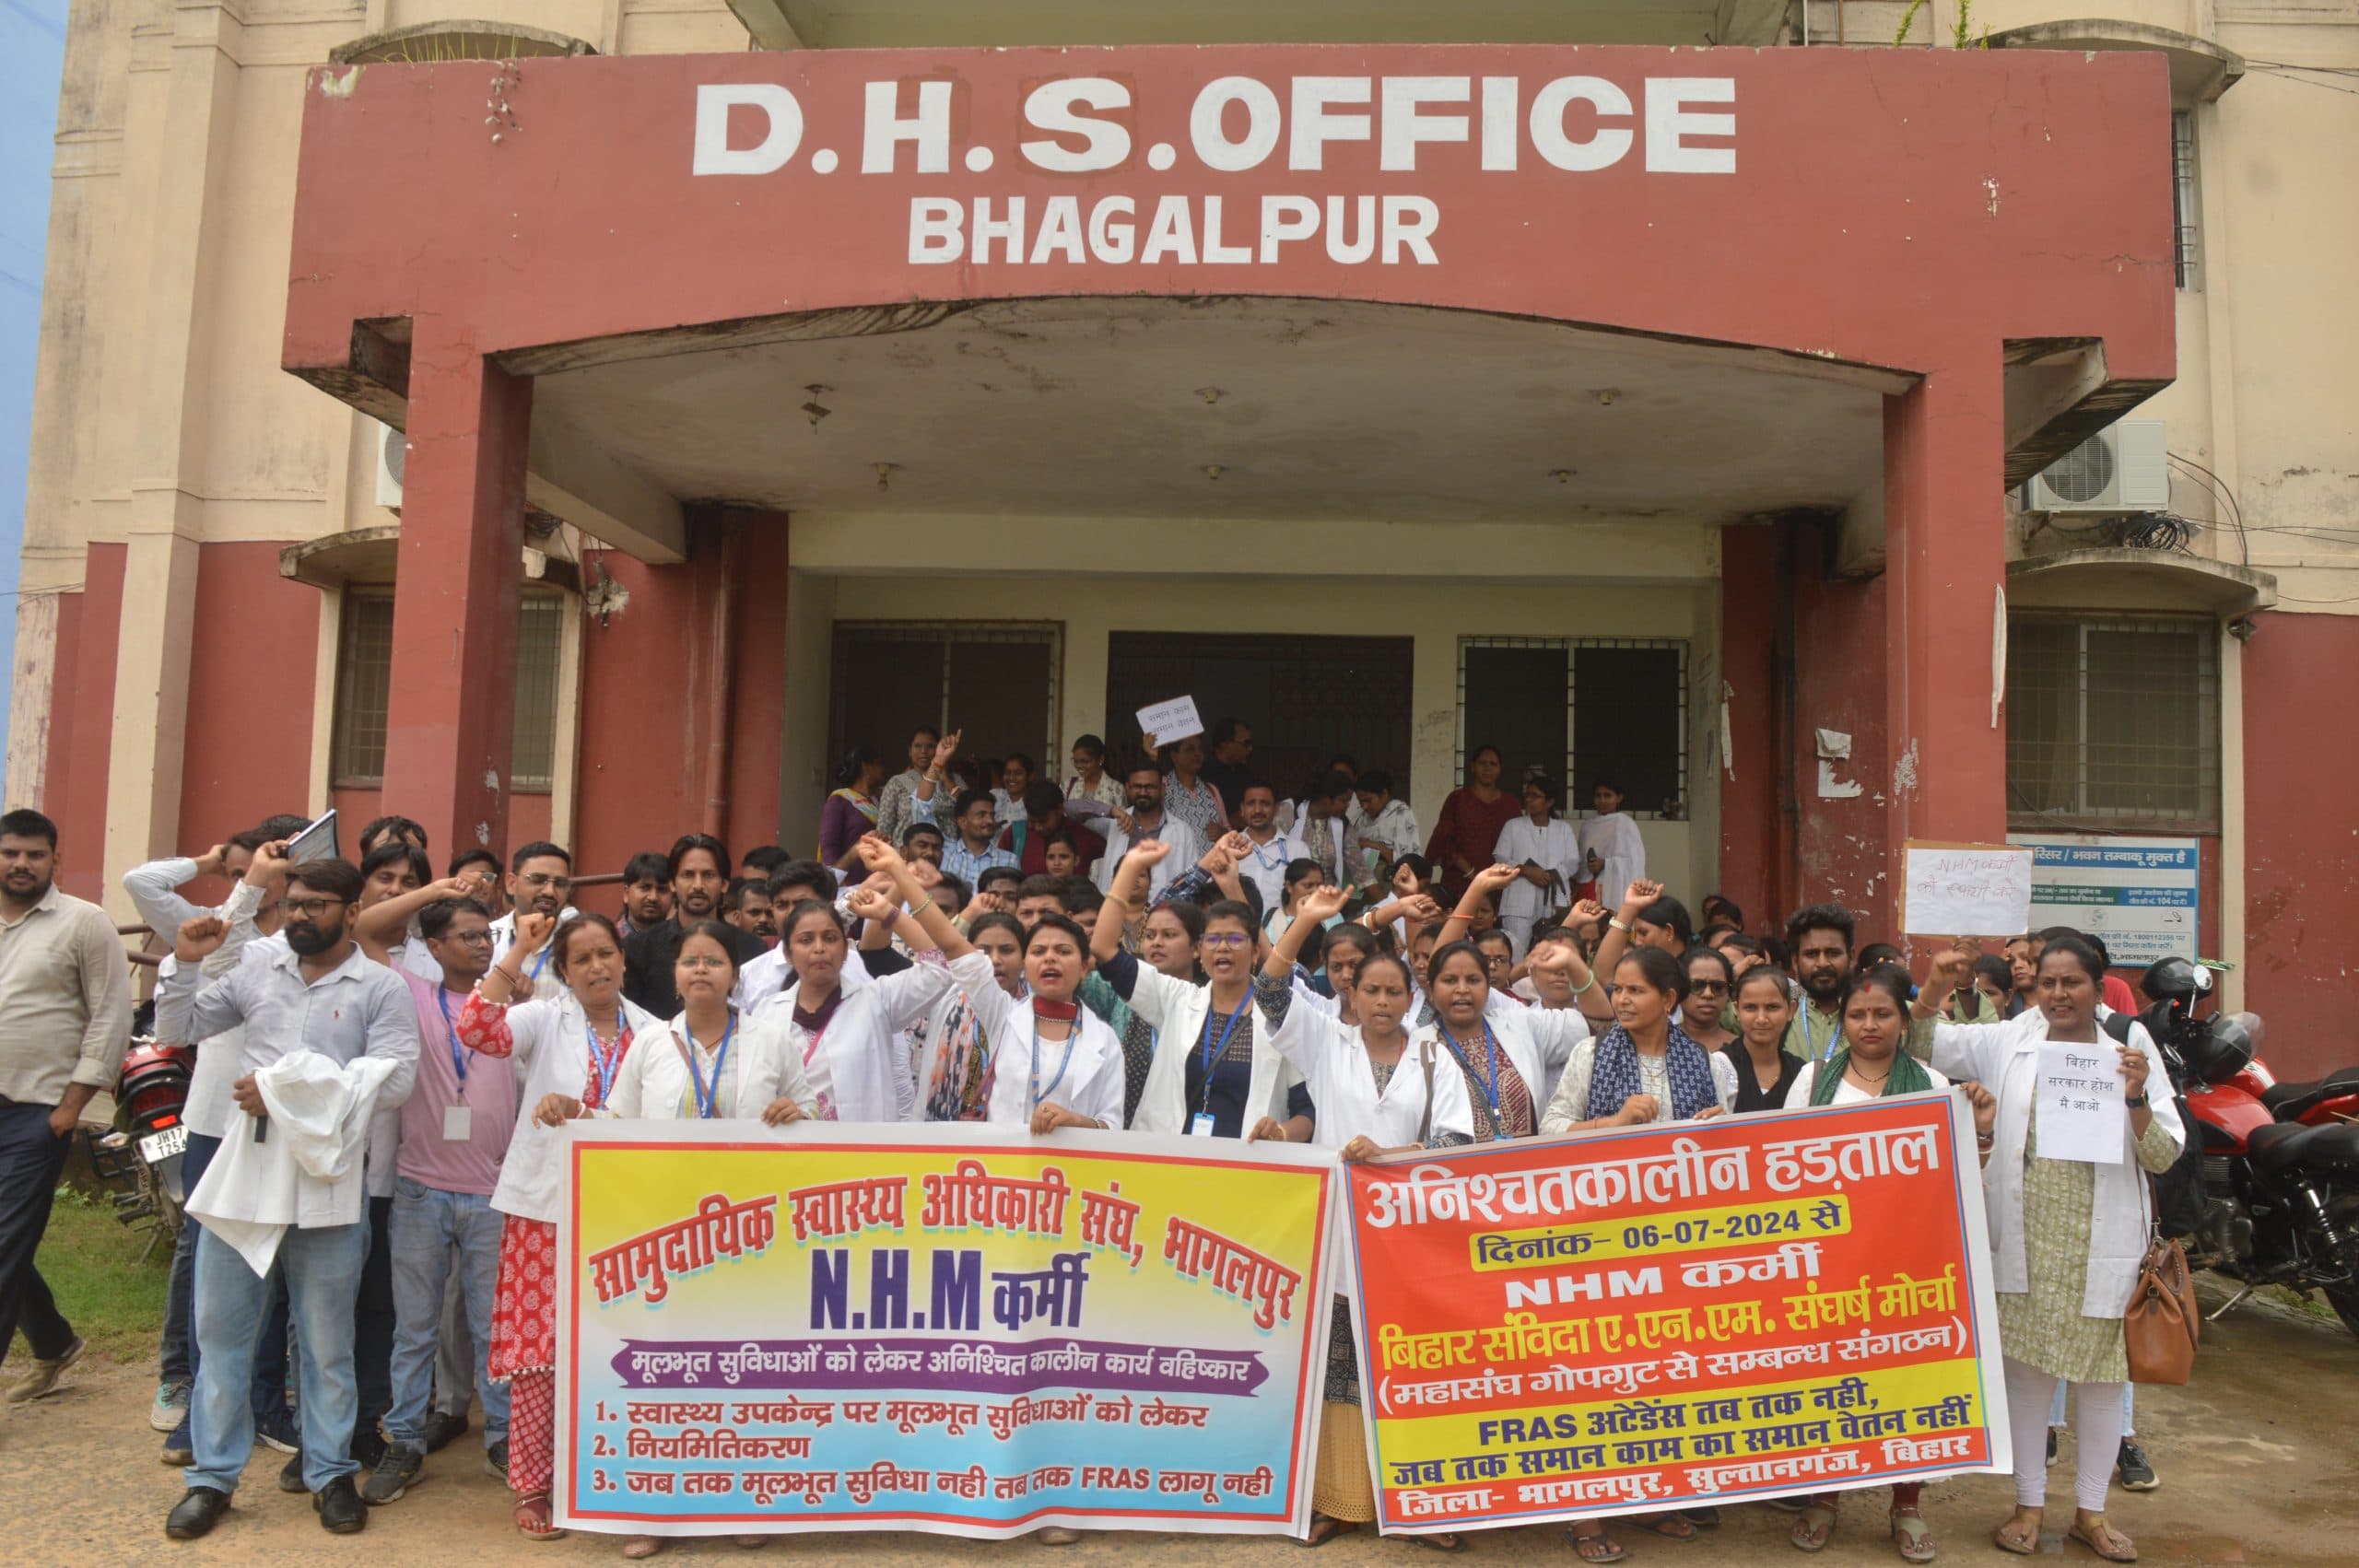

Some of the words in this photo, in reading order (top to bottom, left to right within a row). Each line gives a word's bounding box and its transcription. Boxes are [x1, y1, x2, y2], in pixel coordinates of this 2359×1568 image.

[908, 194, 1440, 264] BHAGALPUR
[2034, 846, 2063, 860] रिसर
[2073, 849, 2102, 861] भवन
[2176, 848, 2187, 864] है
[2157, 896, 2171, 906] 104
[2048, 1076, 2087, 1090] सरकार
[2091, 1077, 2114, 1094] होश
[2065, 1053, 2099, 1071] बिहार
[2073, 1097, 2101, 1112] आओ
[157, 1127, 182, 1145] JH17
[1762, 1123, 1940, 1191] हड़ताल
[588, 1193, 777, 1304] सामुदायिक
[788, 1176, 908, 1242] स्वास्थ्य
[921, 1159, 1071, 1235] अधिकारी
[1081, 1181, 1144, 1268] संघ,
[1164, 1216, 1302, 1330] भागलपुर
[1624, 1209, 1802, 1249] 06-07-2024
[1809, 1199, 1842, 1230] से
[810, 1248, 981, 1330] N.H.M
[992, 1252, 1091, 1330] कर्मी
[1505, 1266, 1663, 1308] NHM
[1681, 1241, 1824, 1289] कर्मी
[1379, 1323, 1477, 1371] बिहार
[1482, 1311, 1591, 1362] संविदा
[1783, 1274, 1872, 1331] संघर्ष
[1876, 1263, 1957, 1317] मोर्चा
[631, 1350, 712, 1384] मूलभूत
[718, 1343, 823, 1384] सुविधाओं
[826, 1343, 857, 1373] को
[863, 1343, 923, 1373] लेकर
[927, 1342, 1027, 1376] अनिश्चित
[1030, 1341, 1100, 1373] कालीन
[1105, 1348, 1156, 1375] कार्य
[1158, 1349, 1251, 1381] वहिष्कार
[1379, 1367, 1522, 1415] (महासंघ
[1528, 1360, 1661, 1395] गोपगुट
[1663, 1351, 1700, 1380] से
[1704, 1341, 1832, 1376] सम्बन्ध
[1836, 1316, 1967, 1359] संगठन)
[596, 1399, 617, 1422] 1.
[627, 1401, 724, 1424] स्वास्थ्य
[732, 1394, 835, 1428] उपकेन्द्र
[842, 1401, 881, 1423] पर
[886, 1400, 980, 1435] मूलभूत
[987, 1393, 1093, 1441] सुविधाओं
[1095, 1395, 1133, 1423] को
[1140, 1397, 1210, 1428] लेकर
[1389, 1458, 1446, 1486] जब
[1450, 1452, 1508, 1481] तक
[1515, 1444, 1606, 1475] समान
[1613, 1436, 1684, 1465] काम
[1690, 1431, 1736, 1457] का
[1741, 1420, 1831, 1452] समान
[1837, 1410, 1907, 1439] वेतन
[1912, 1394, 1973, 1429] नहीं
[1478, 1413, 1578, 1446] FRAS
[1692, 1397, 1743, 1425] तब
[1747, 1389, 1804, 1419] तक
[593, 1434, 616, 1457] 2.
[627, 1428, 812, 1459] नियमितिकरण
[593, 1469, 616, 1491] 3.
[626, 1471, 675, 1493] जब
[683, 1472, 734, 1493] तक
[742, 1471, 837, 1504] मूलभूत
[845, 1461, 930, 1504] सुविधा
[936, 1465, 986, 1498] नही
[994, 1474, 1028, 1500] तब
[1031, 1467, 1074, 1492] तक
[1081, 1467, 1150, 1490] FRAS
[1158, 1470, 1218, 1503] लागू
[1223, 1466, 1273, 1496] नही
[1518, 1472, 1674, 1504] भागलपुर,
[1880, 1435, 1972, 1466] बिहार
